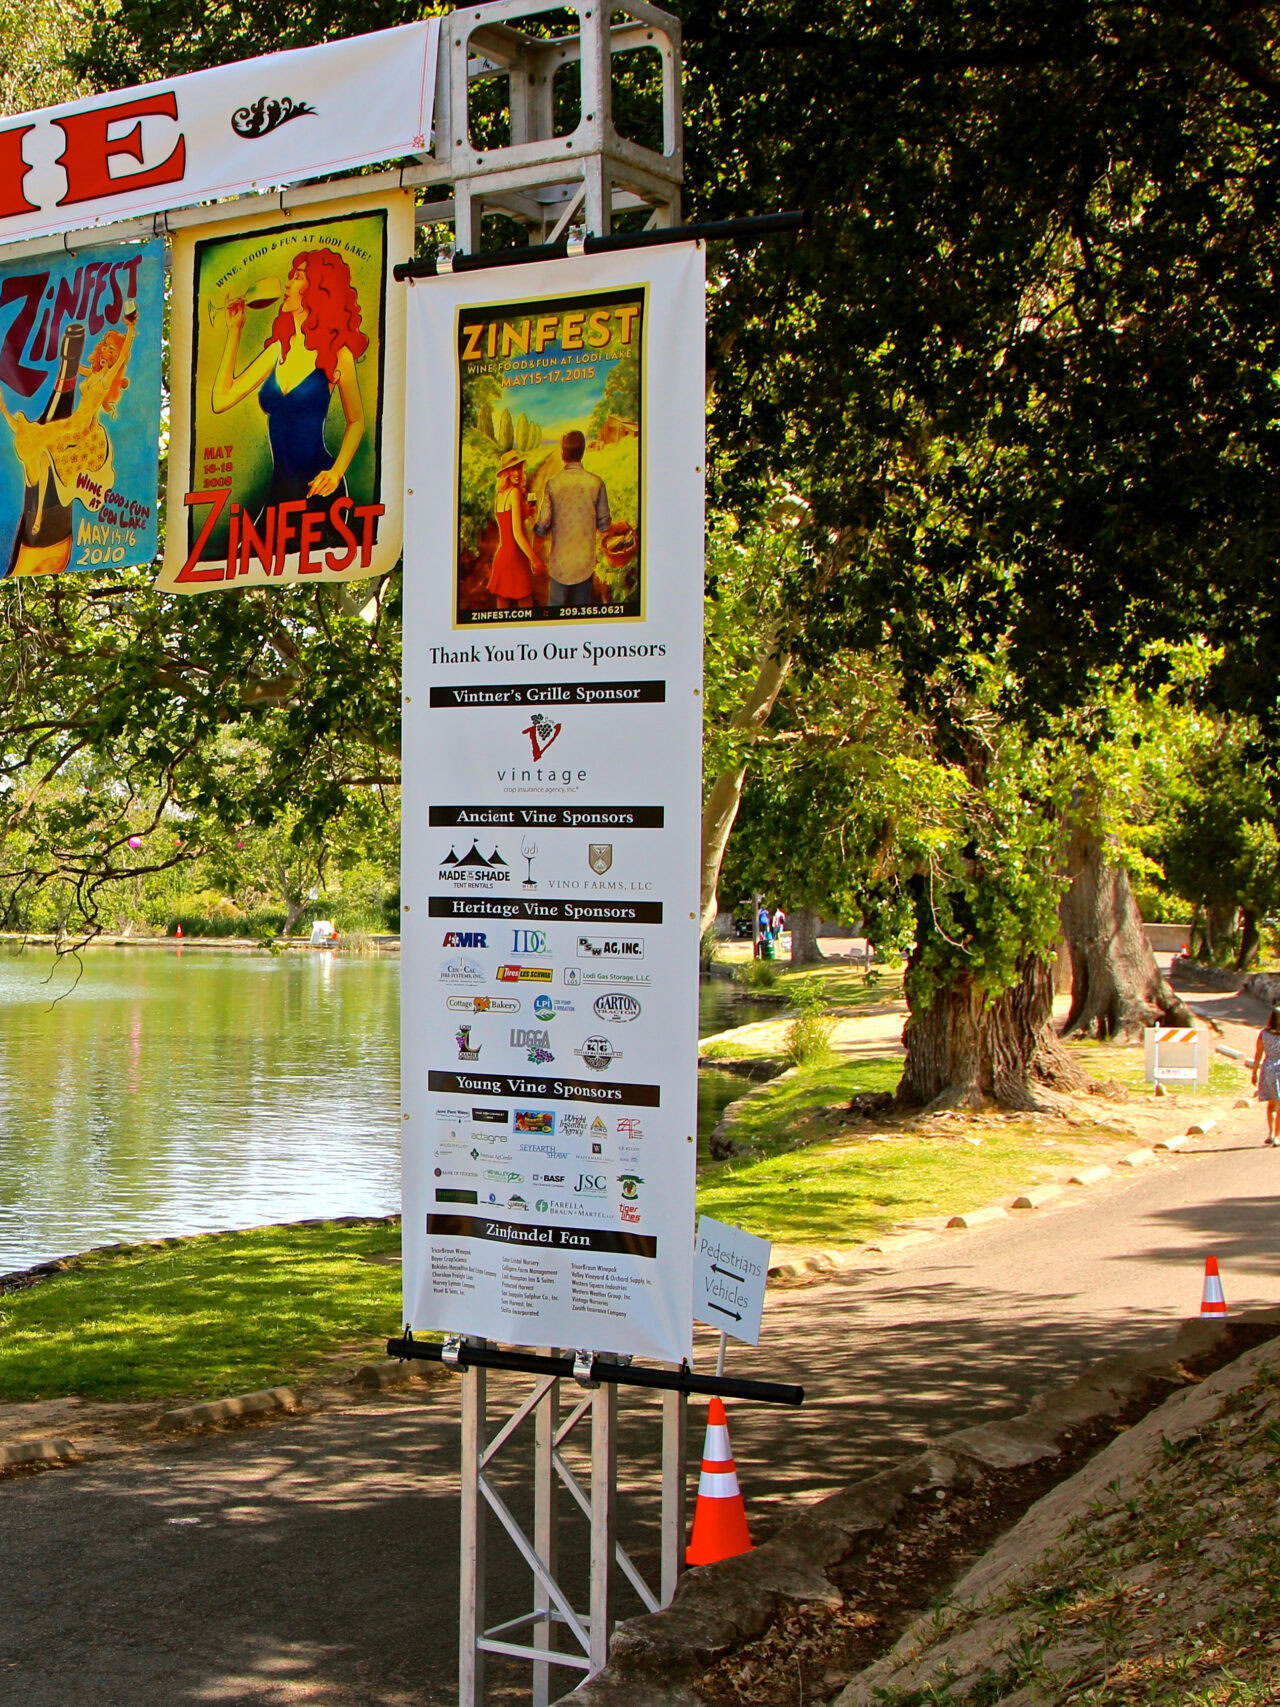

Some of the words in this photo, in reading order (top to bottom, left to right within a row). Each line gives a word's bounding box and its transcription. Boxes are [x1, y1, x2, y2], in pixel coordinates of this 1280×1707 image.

[215, 265, 242, 288] WINE,
[242, 247, 268, 267] FOOD
[279, 235, 298, 247] FUN
[302, 235, 315, 243] AT
[319, 235, 342, 247] LODI
[462, 306, 640, 361] ZINFEST
[560, 355, 573, 365] AT
[576, 352, 602, 364] LODI
[605, 349, 632, 361] LAKE
[203, 445, 234, 460] MAY
[76, 472, 102, 497] WINE
[104, 488, 125, 508] FOOD
[129, 500, 150, 519] FUN
[120, 512, 147, 530] LAKE
[77, 517, 110, 547] MAY
[76, 546, 126, 566] 2010
[471, 609, 532, 621] ZINFEST.COM
[559, 605, 625, 617] 209.365.0621
[429, 645, 480, 664] Thank
[484, 645, 515, 662] You
[517, 643, 538, 661] To
[543, 642, 578, 660] Our
[582, 641, 666, 666] Sponsors
[526, 687, 571, 702] Grille
[576, 686, 641, 702] Sponsor
[497, 768, 587, 785] vintage
[456, 810, 515, 823] Ancient
[520, 810, 557, 823] Vine
[562, 811, 634, 826] Sponsors
[438, 870, 466, 881] MADE
[475, 870, 511, 882] SHADE
[549, 880, 580, 889] VINO
[584, 881, 627, 891] FARMS,
[630, 882, 652, 891] LLC
[452, 901, 520, 917] Heritage
[523, 902, 558, 916] Vine
[564, 904, 636, 919] Sponsors
[603, 942, 620, 955] AG,
[622, 942, 642, 955] INC.
[449, 999, 472, 1009] Cottage
[491, 1002, 517, 1010] Bakery
[596, 996, 637, 1011] GARTON
[456, 1076, 502, 1092] Young
[507, 1079, 547, 1093] Vine
[554, 1081, 622, 1099] Sponsors
[519, 1144, 556, 1153] SEYFARTH
[547, 1151, 569, 1159] SHAW
[543, 1174, 566, 1182] BASF
[573, 1173, 608, 1192] JSC
[550, 1200, 584, 1209] FARELLA
[619, 1203, 638, 1213] tiger
[486, 1223, 553, 1244] Zinfandel
[560, 1231, 591, 1246] Fan
[700, 1238, 762, 1277] Pedestrians
[571, 1271, 584, 1279] Valley
[584, 1273, 605, 1281] Vineyard
[610, 1275, 629, 1283] Orchard
[604, 1283, 627, 1291] Industries
[704, 1276, 749, 1309] Vehicles
[607, 1308, 627, 1318] Company
